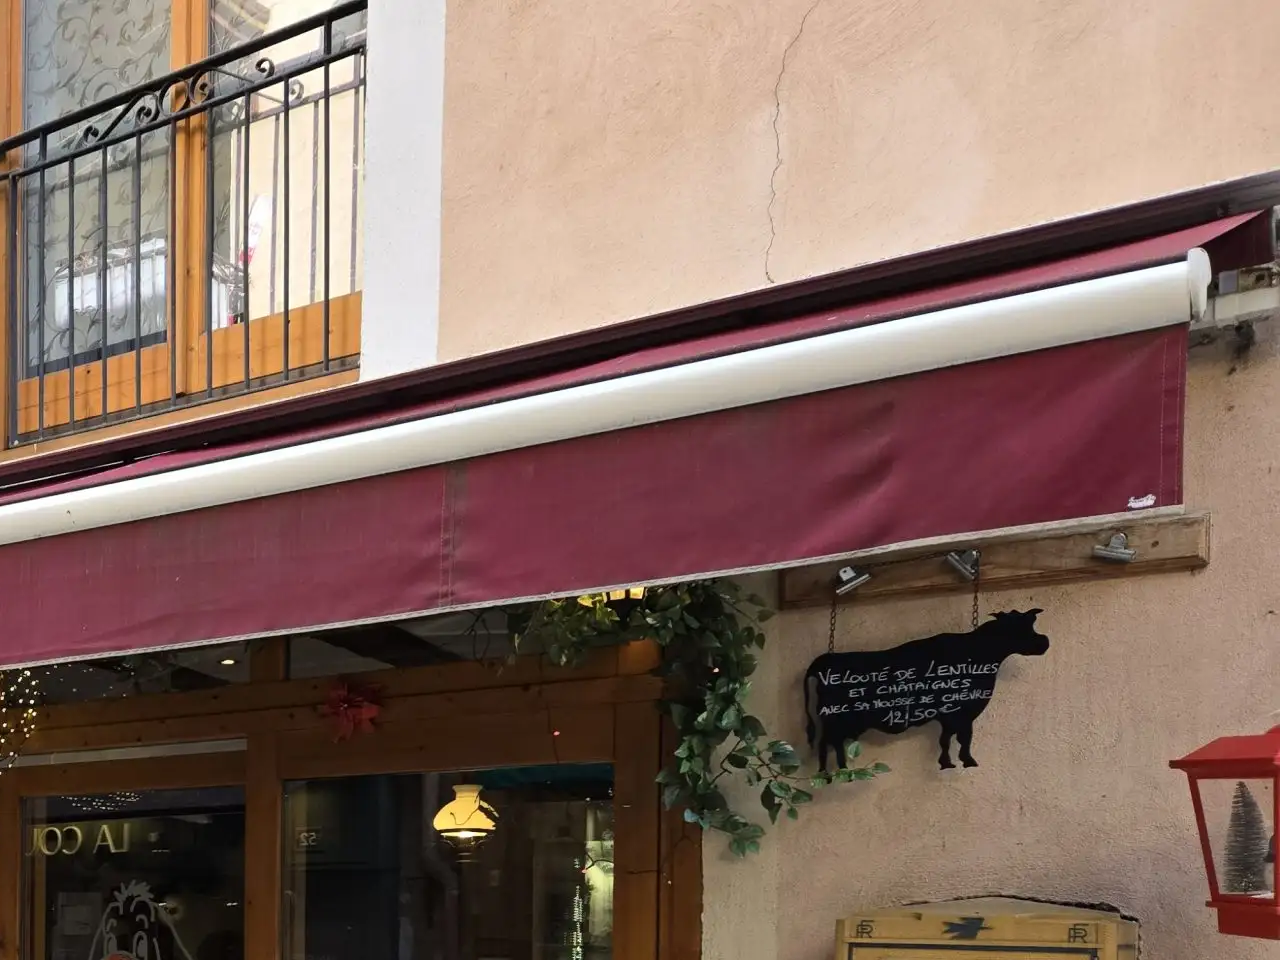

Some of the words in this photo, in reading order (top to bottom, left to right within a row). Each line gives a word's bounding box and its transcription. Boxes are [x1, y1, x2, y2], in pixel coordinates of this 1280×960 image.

[895, 668, 917, 682] DE
[848, 687, 867, 698] ET
[819, 703, 850, 717] AVEC
[853, 700, 871, 712] SA
[921, 694, 936, 704] DE
